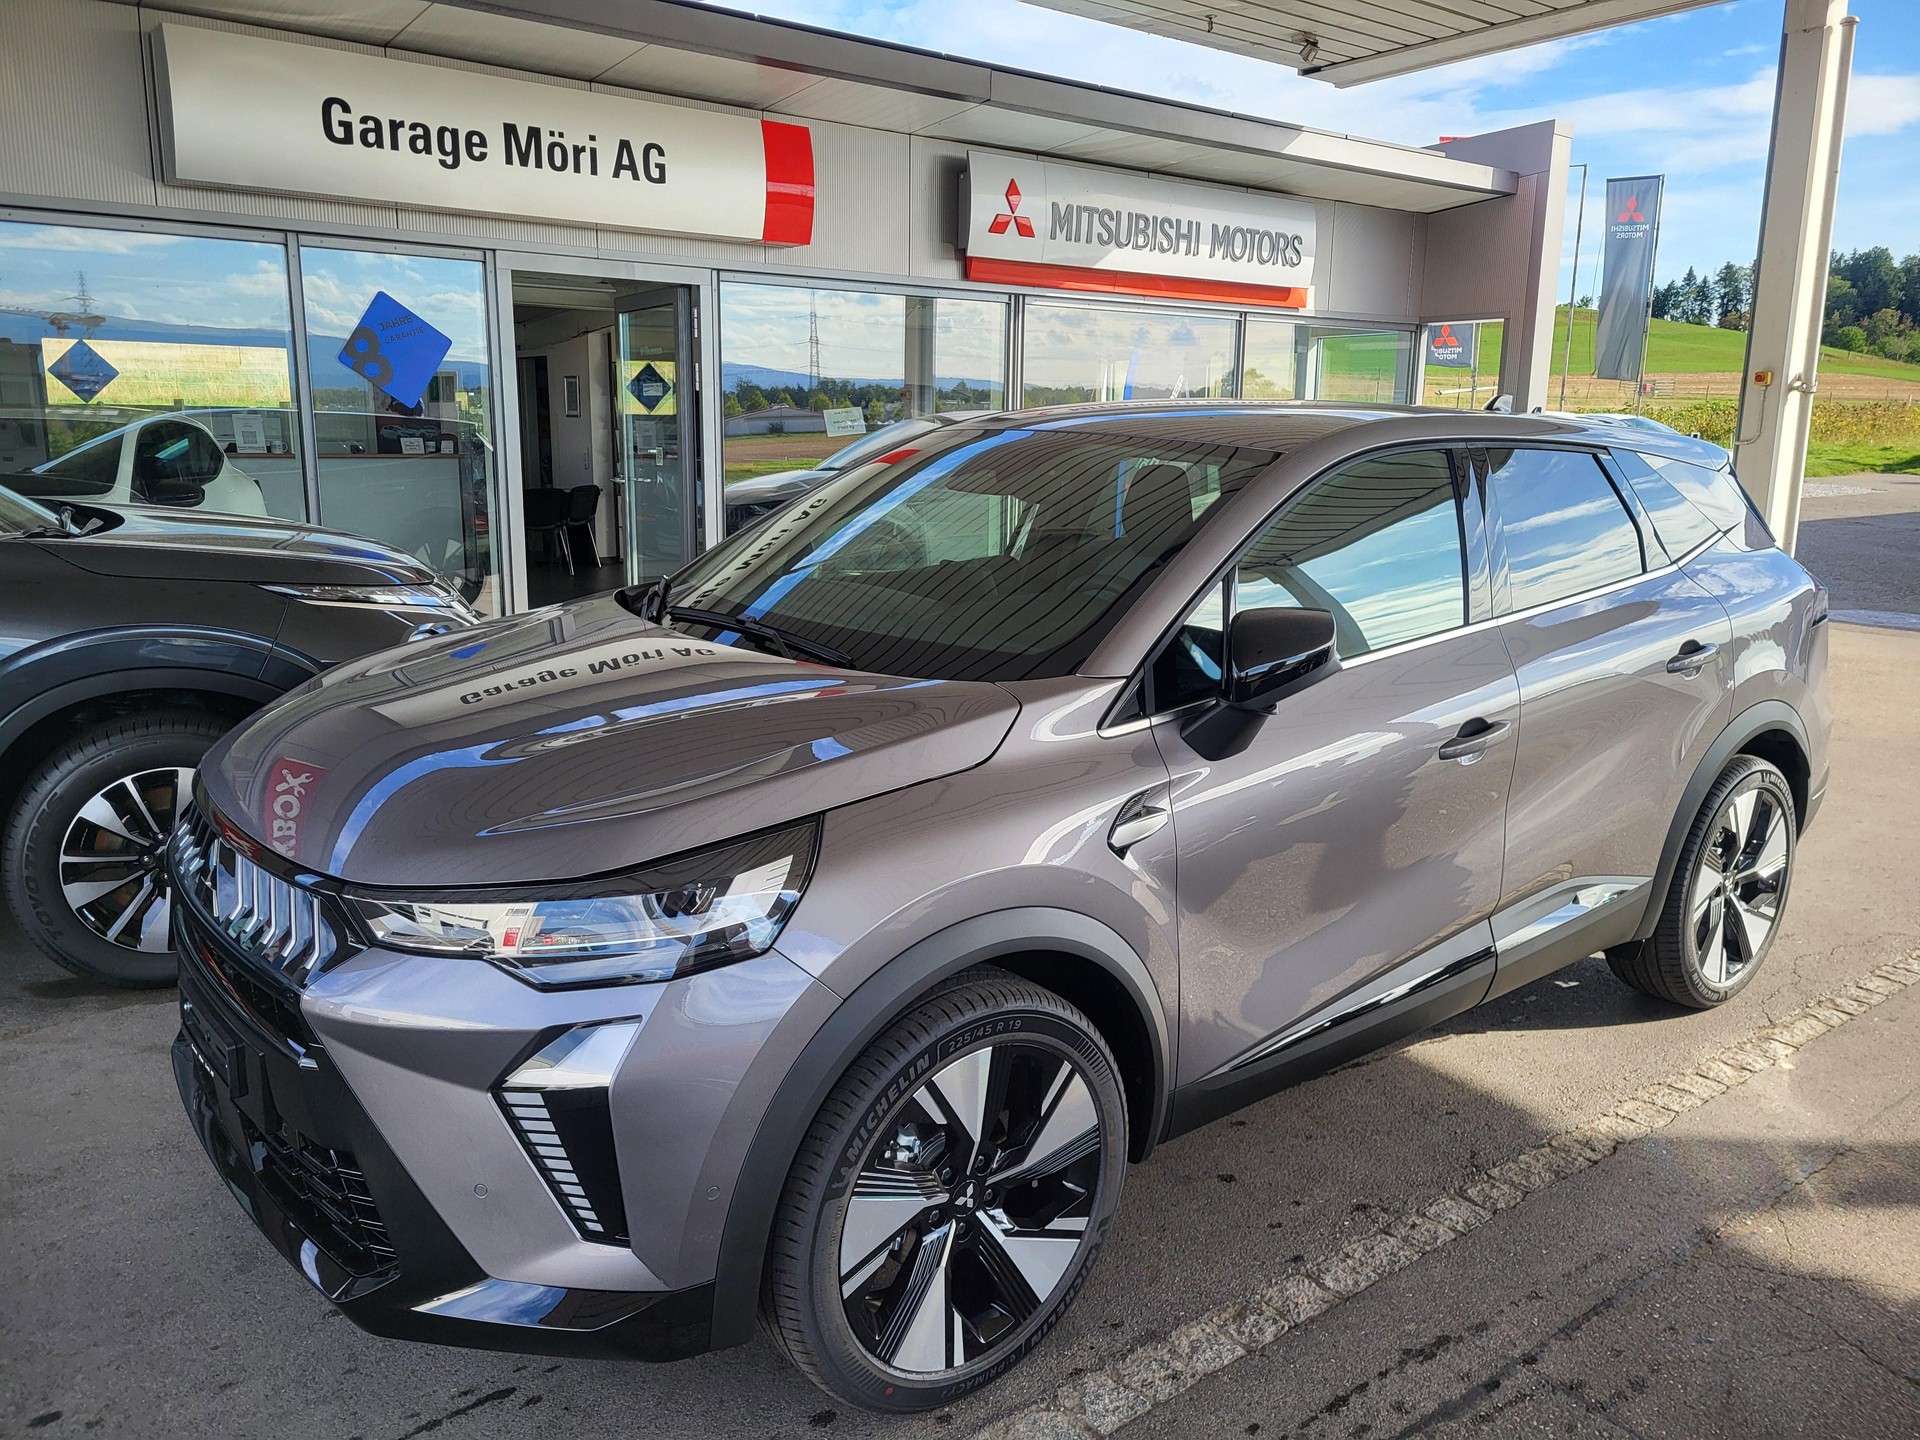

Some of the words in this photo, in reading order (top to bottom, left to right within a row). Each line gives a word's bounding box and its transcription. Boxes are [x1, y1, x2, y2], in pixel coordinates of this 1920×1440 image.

[321, 96, 488, 170] Garage
[502, 121, 598, 176] Möri
[612, 138, 666, 184] AG
[1050, 202, 1201, 257] MITSUBISHI
[1208, 223, 1304, 268] MOTORS
[378, 314, 413, 332] JAHRE
[384, 326, 425, 344] GARANTIE
[343, 326, 394, 387] 8
[25, 875, 63, 941] TOYO
[846, 1053, 930, 1163] MICHELIN
[948, 1024, 992, 1052] 225/45
[996, 1022, 1005, 1032] R
[1008, 1019, 1022, 1030] 19
[1030, 1245, 1098, 1348] MICHELIN
